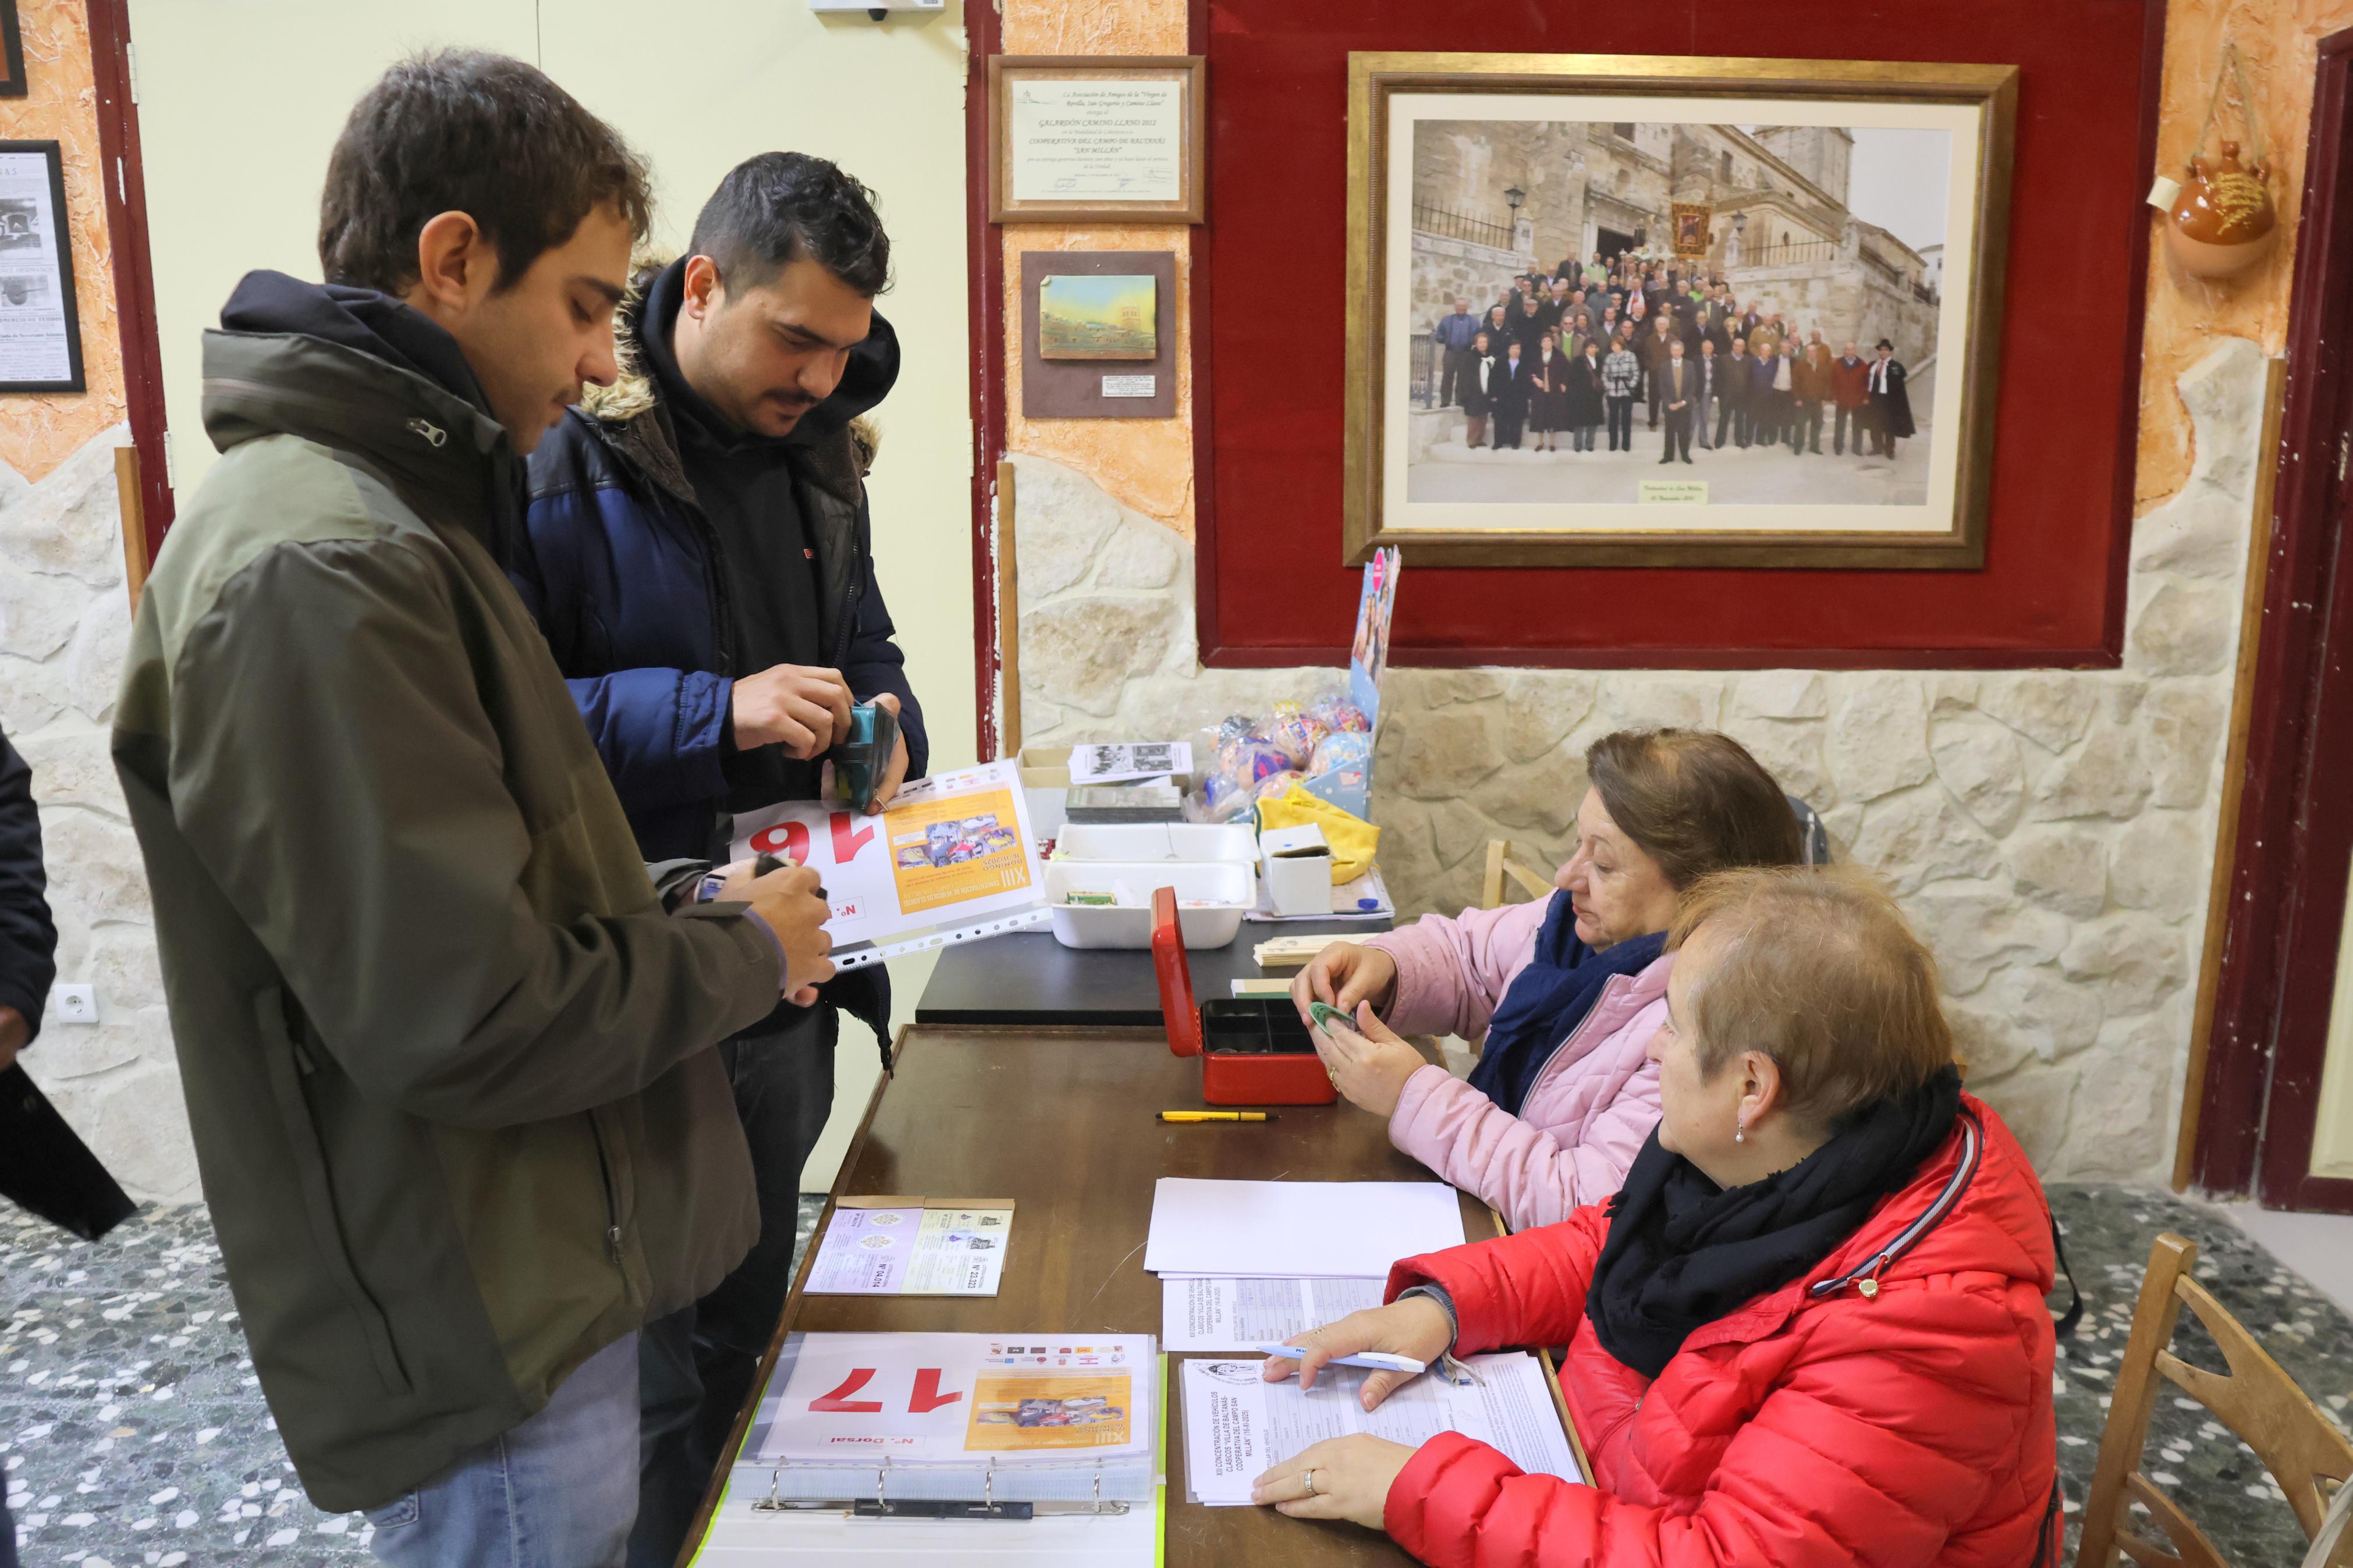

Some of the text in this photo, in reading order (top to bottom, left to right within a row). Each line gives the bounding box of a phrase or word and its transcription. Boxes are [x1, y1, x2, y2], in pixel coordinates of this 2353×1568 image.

[750, 811, 875, 866] 16
[983, 851, 1020, 863] 16/11/2025
[983, 858, 1023, 872] DOMINGO
[1000, 866, 1027, 887] XIII
[872, 1270, 884, 1288] 04.014
[967, 1271, 978, 1289] 23.323
[808, 1368, 963, 1413] 17
[1211, 1391, 1219, 1417] VEHÍCULOS
[1231, 1407, 1239, 1425] CAMPO
[1241, 1410, 1251, 1435] (16-XI-2025)
[1095, 1432, 1124, 1445] XIII
[1233, 1425, 1241, 1435] DEL
[1213, 1425, 1222, 1467] CONCENTRACIÓN
[1234, 1435, 1243, 1471] COOPERATIVA
[1225, 1446, 1233, 1472] CLÁSICOS
